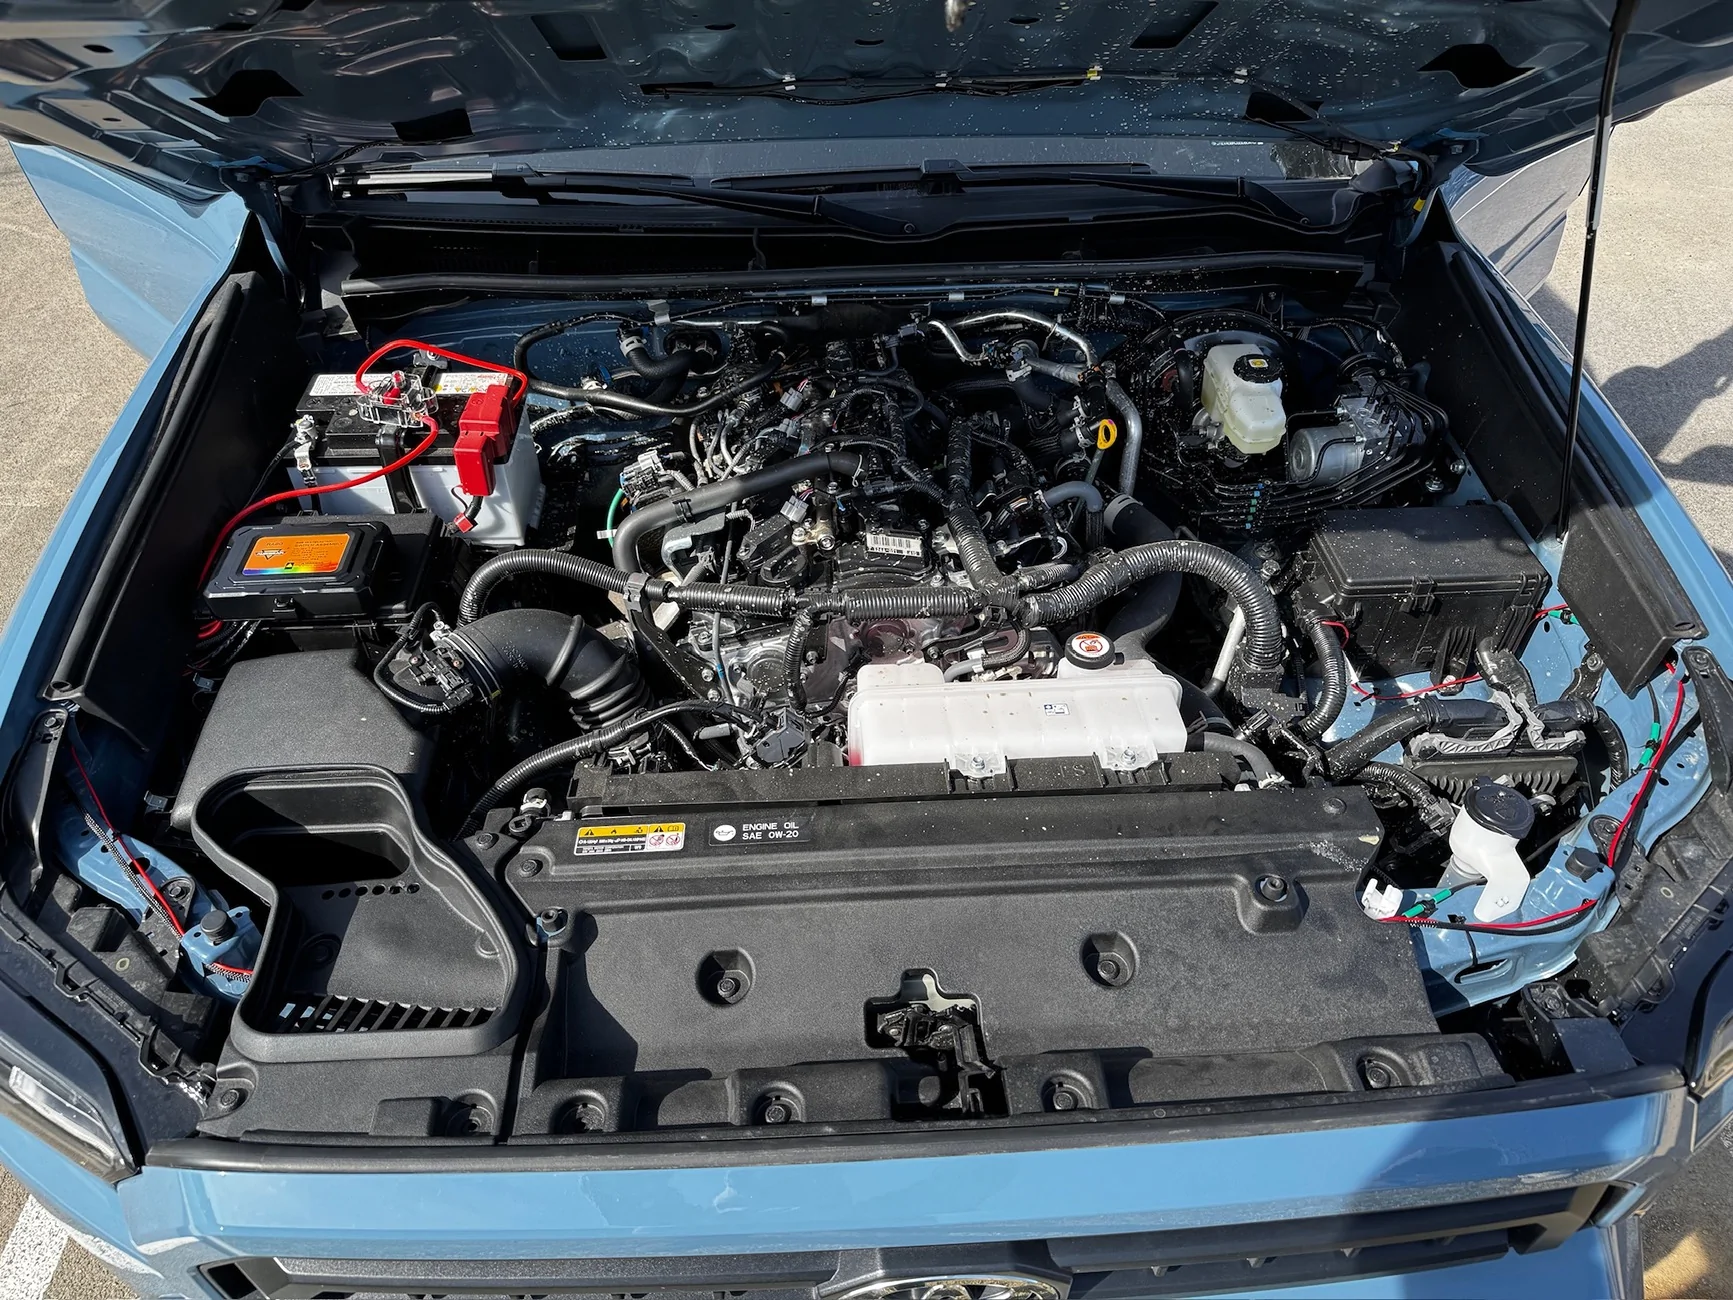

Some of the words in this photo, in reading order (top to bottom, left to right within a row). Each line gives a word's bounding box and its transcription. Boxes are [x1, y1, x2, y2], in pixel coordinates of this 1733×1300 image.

[742, 822, 778, 831] ENGINE
[742, 832, 762, 840] SAE
[768, 830, 799, 839] 0W-20
